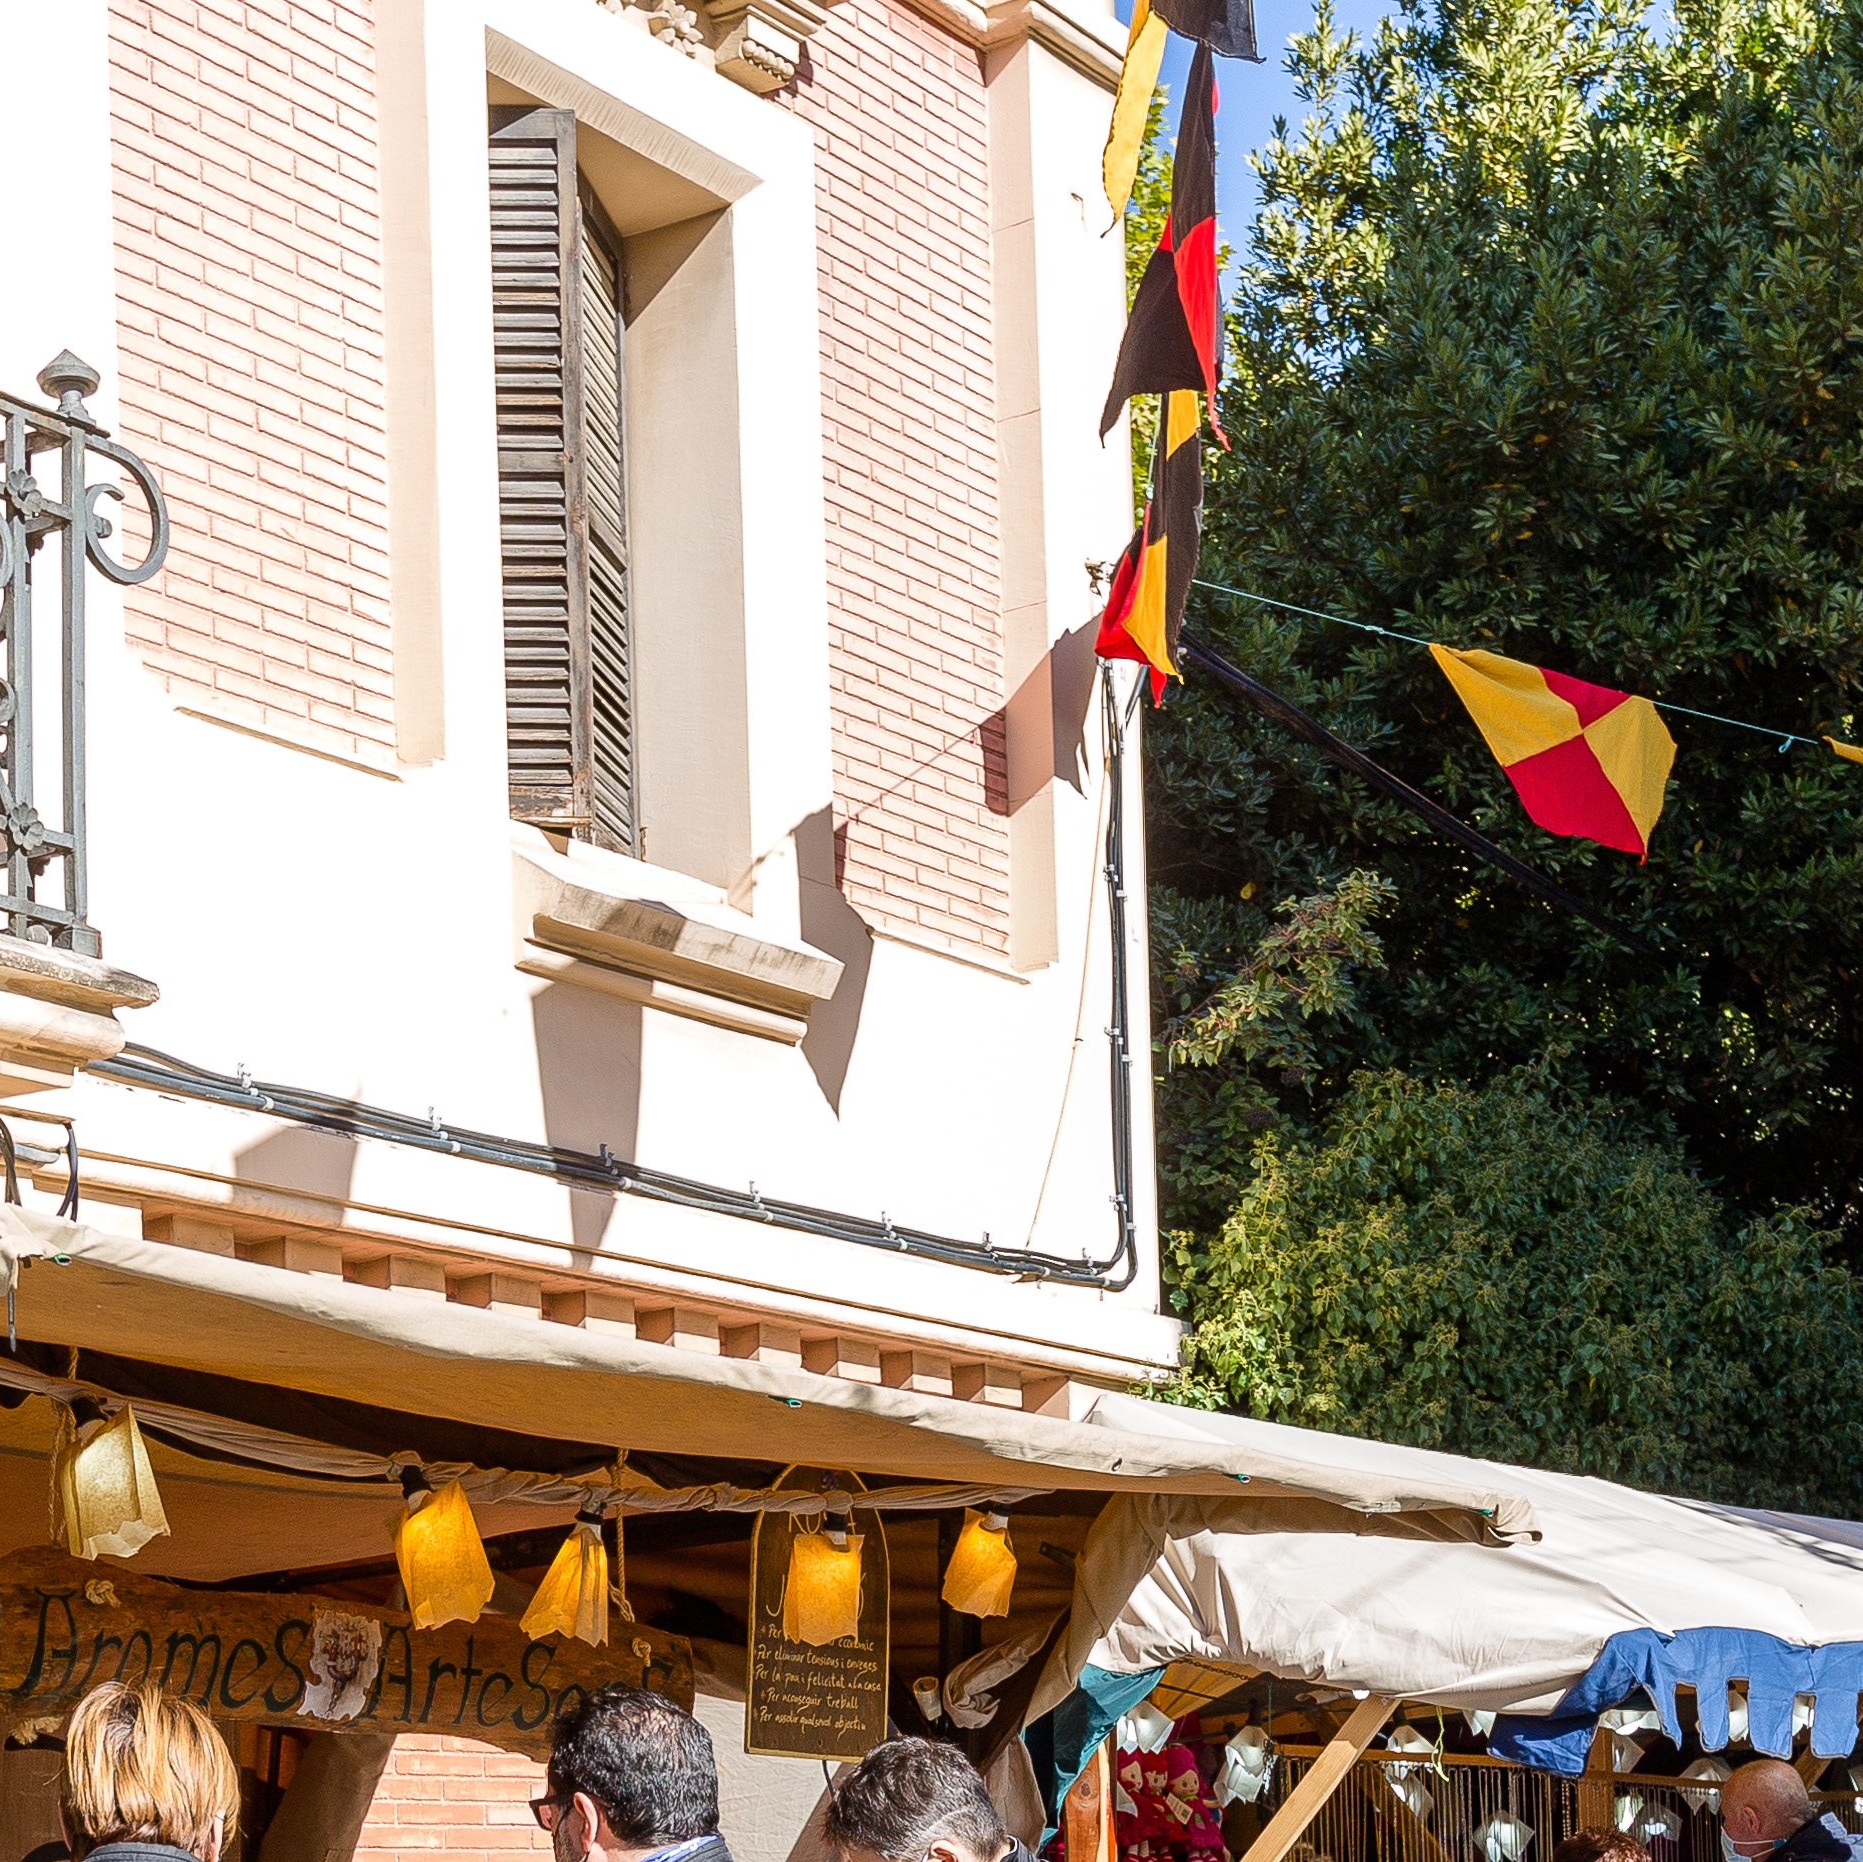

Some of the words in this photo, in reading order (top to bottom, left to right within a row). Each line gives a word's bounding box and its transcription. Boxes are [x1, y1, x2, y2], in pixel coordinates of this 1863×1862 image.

[768, 1623, 782, 1639] Per
[757, 1643, 772, 1660] Per
[755, 1663, 769, 1680] Per
[772, 1666, 781, 1682] la
[767, 1686, 780, 1703] Per
[826, 1692, 859, 1709] treball
[759, 1705, 773, 1723] Per
